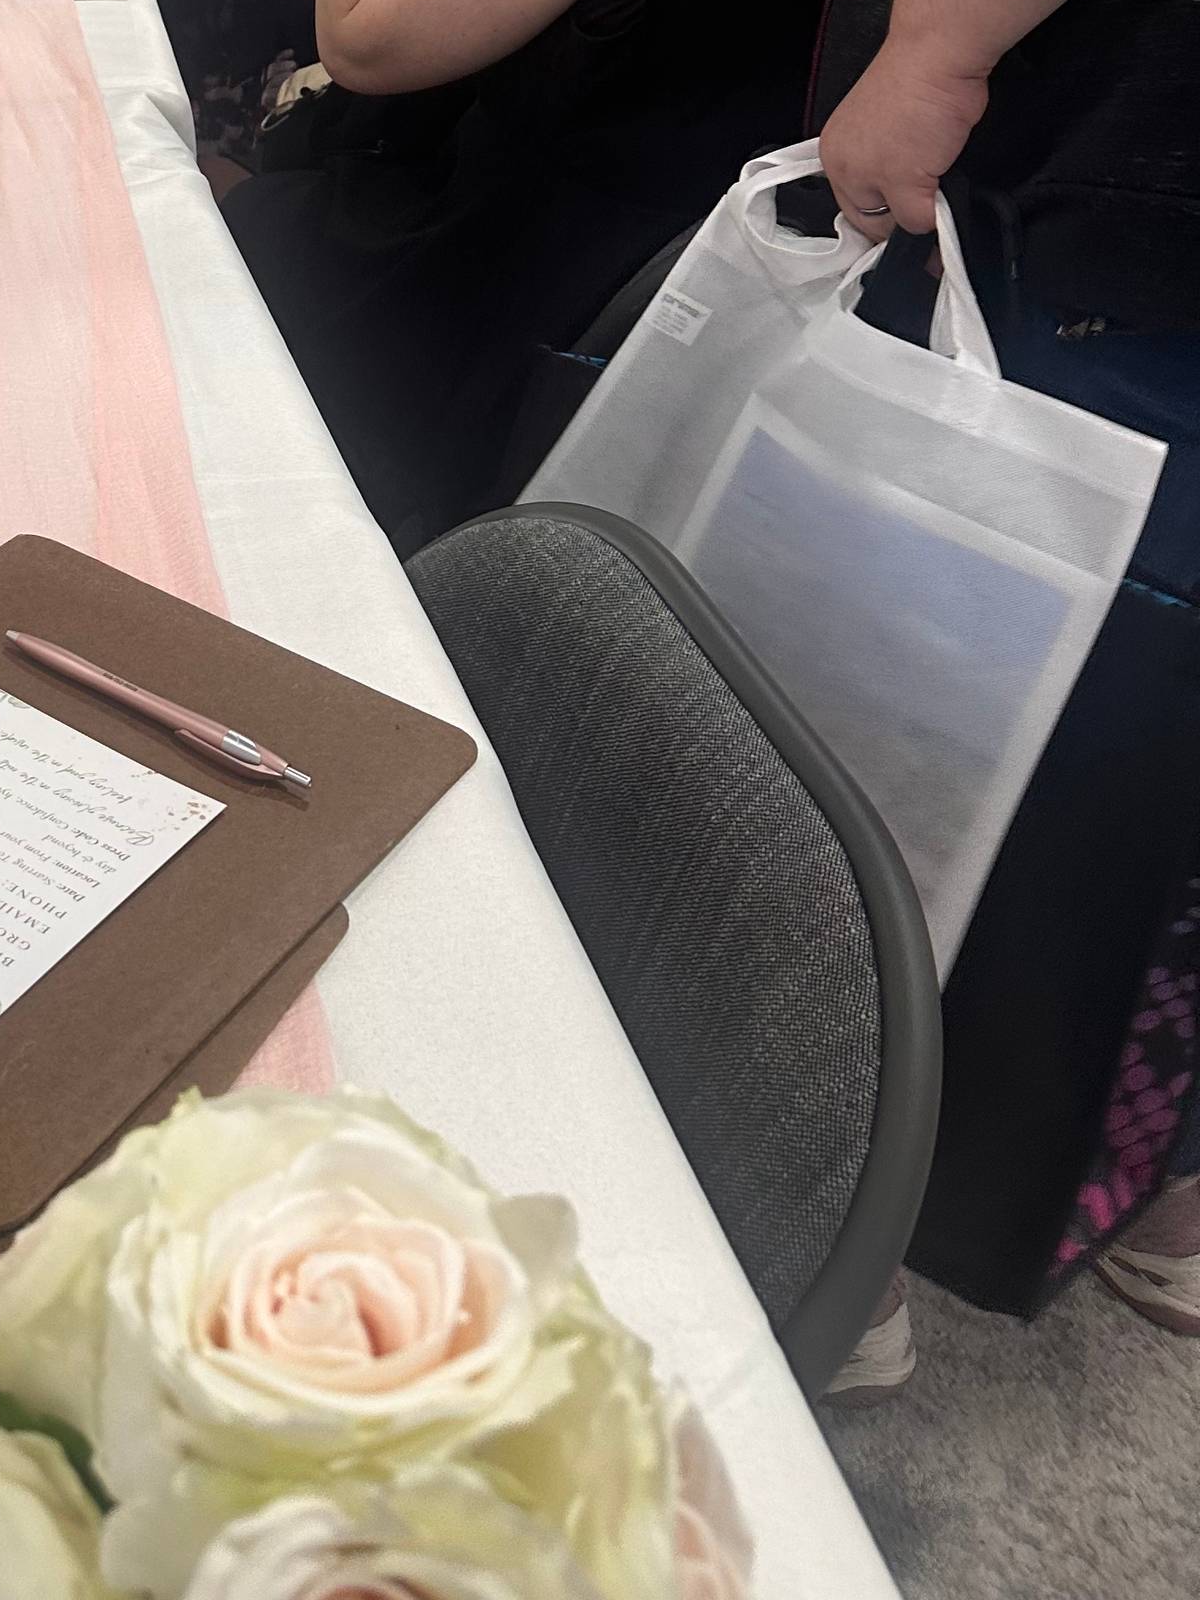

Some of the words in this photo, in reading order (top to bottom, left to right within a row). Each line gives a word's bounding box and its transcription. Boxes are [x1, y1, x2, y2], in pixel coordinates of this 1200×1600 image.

[15, 796, 70, 830] Confidence,
[70, 827, 100, 846] Code:
[23, 844, 52, 863] From
[100, 843, 131, 862] Dress
[11, 858, 56, 886] Starting
[52, 860, 101, 889] Location:
[1, 879, 68, 920] PHONE:
[56, 883, 86, 903] Date:
